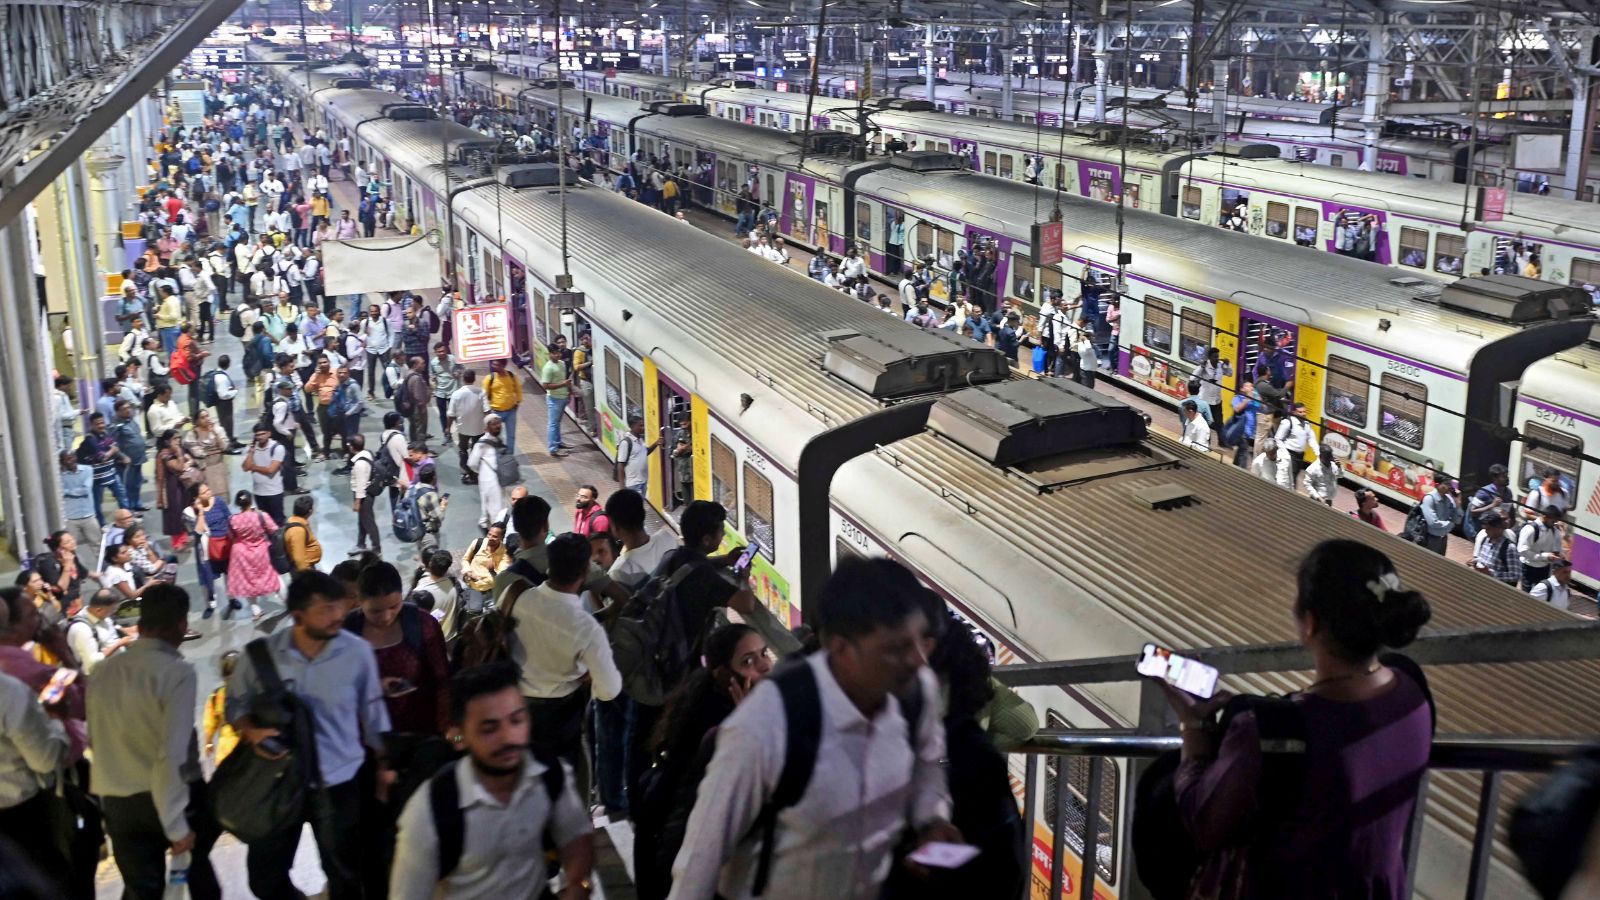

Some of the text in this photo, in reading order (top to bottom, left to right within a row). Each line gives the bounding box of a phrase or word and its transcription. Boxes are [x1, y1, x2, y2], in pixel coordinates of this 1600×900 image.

[1388, 360, 1420, 378] 5280C
[1536, 406, 1575, 428] 5277A
[841, 519, 869, 550] 5310A
